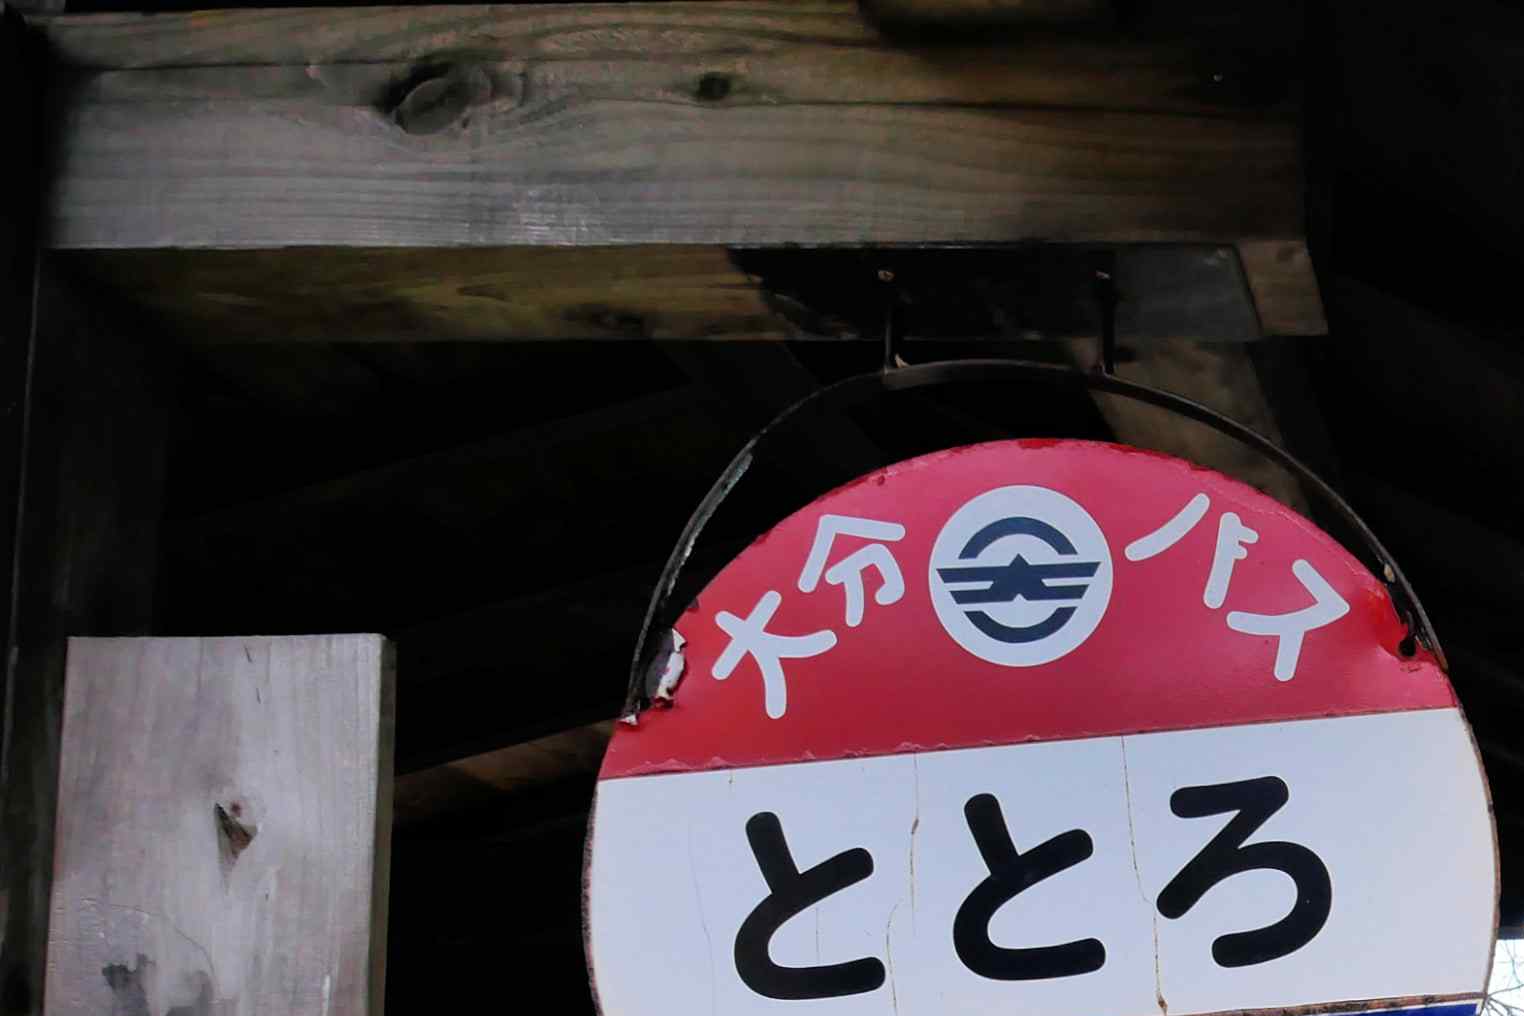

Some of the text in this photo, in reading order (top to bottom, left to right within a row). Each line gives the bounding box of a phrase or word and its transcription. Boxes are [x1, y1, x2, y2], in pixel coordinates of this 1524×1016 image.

[711, 492, 1350, 720] 大分 バス
[734, 775, 1332, 1001] ととろ
